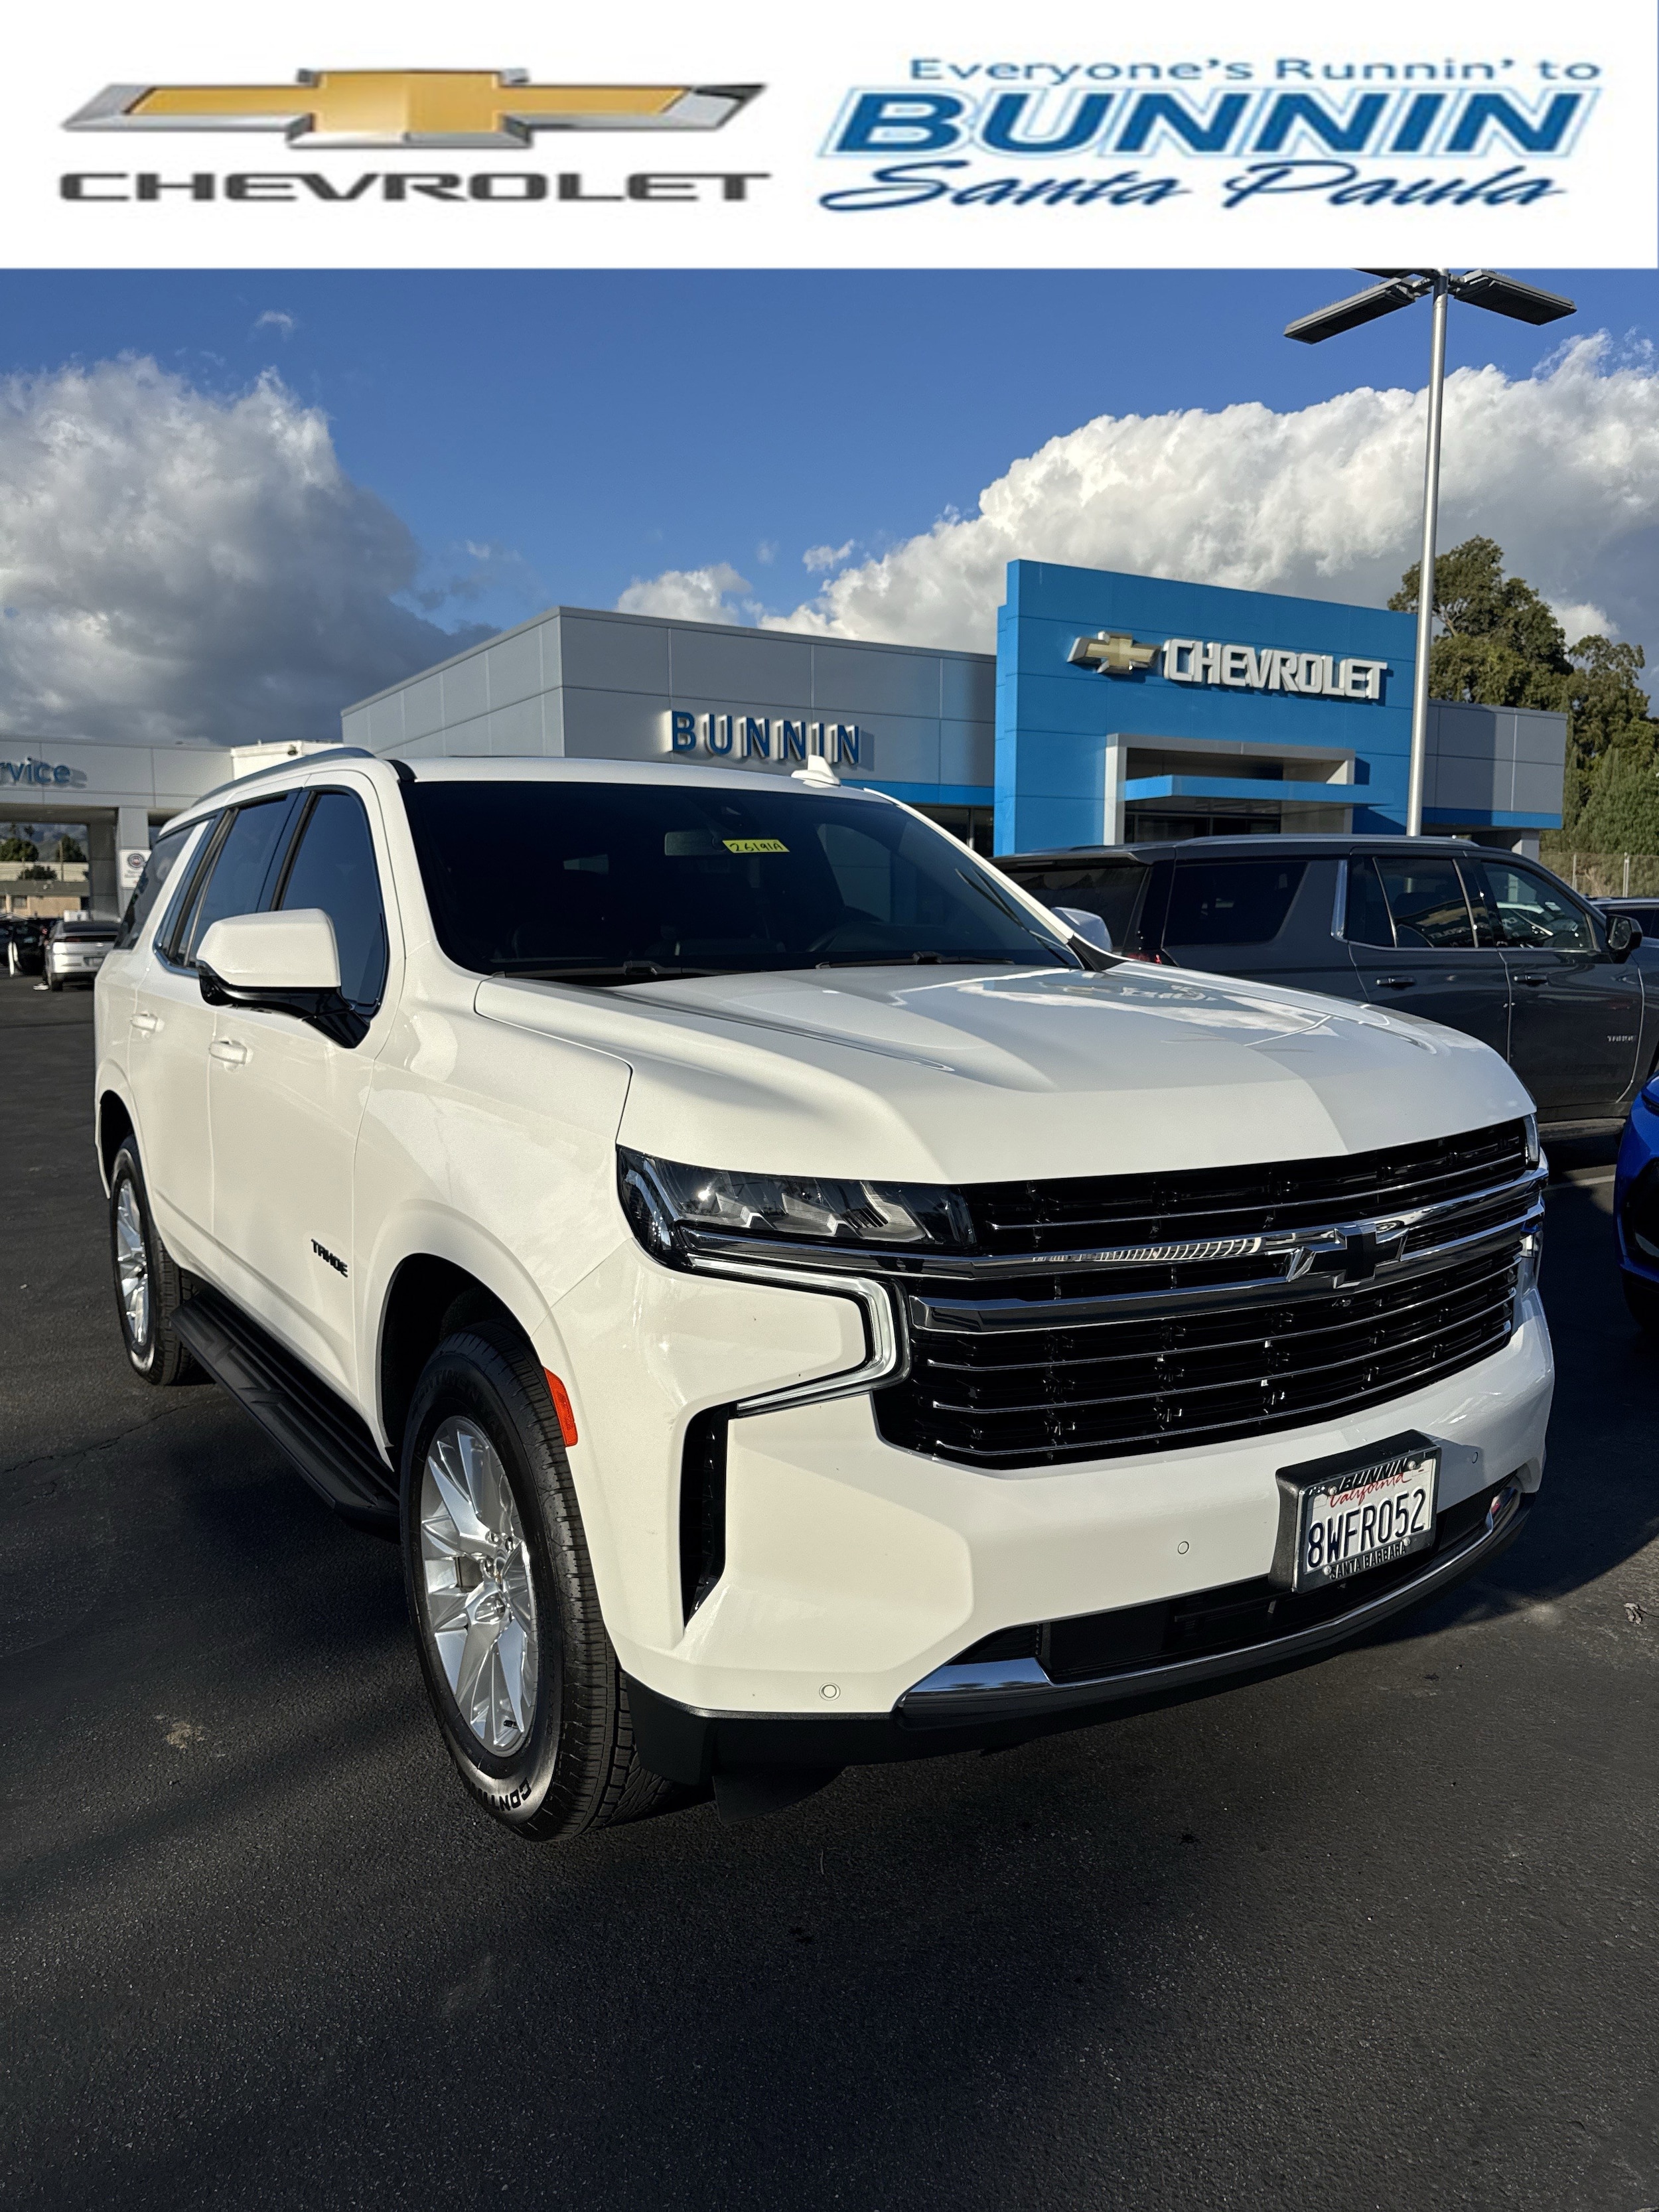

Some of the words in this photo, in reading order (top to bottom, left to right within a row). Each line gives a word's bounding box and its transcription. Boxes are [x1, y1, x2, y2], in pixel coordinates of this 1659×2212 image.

[1163, 638, 1388, 700] CHEVROLET
[664, 709, 859, 764] BUNNIN
[311, 1238, 348, 1278] TAHOE
[1307, 1487, 1426, 1568] 8WFR052
[1329, 1559, 1360, 1580] SANTA
[1362, 1541, 1406, 1570] BARBARA
